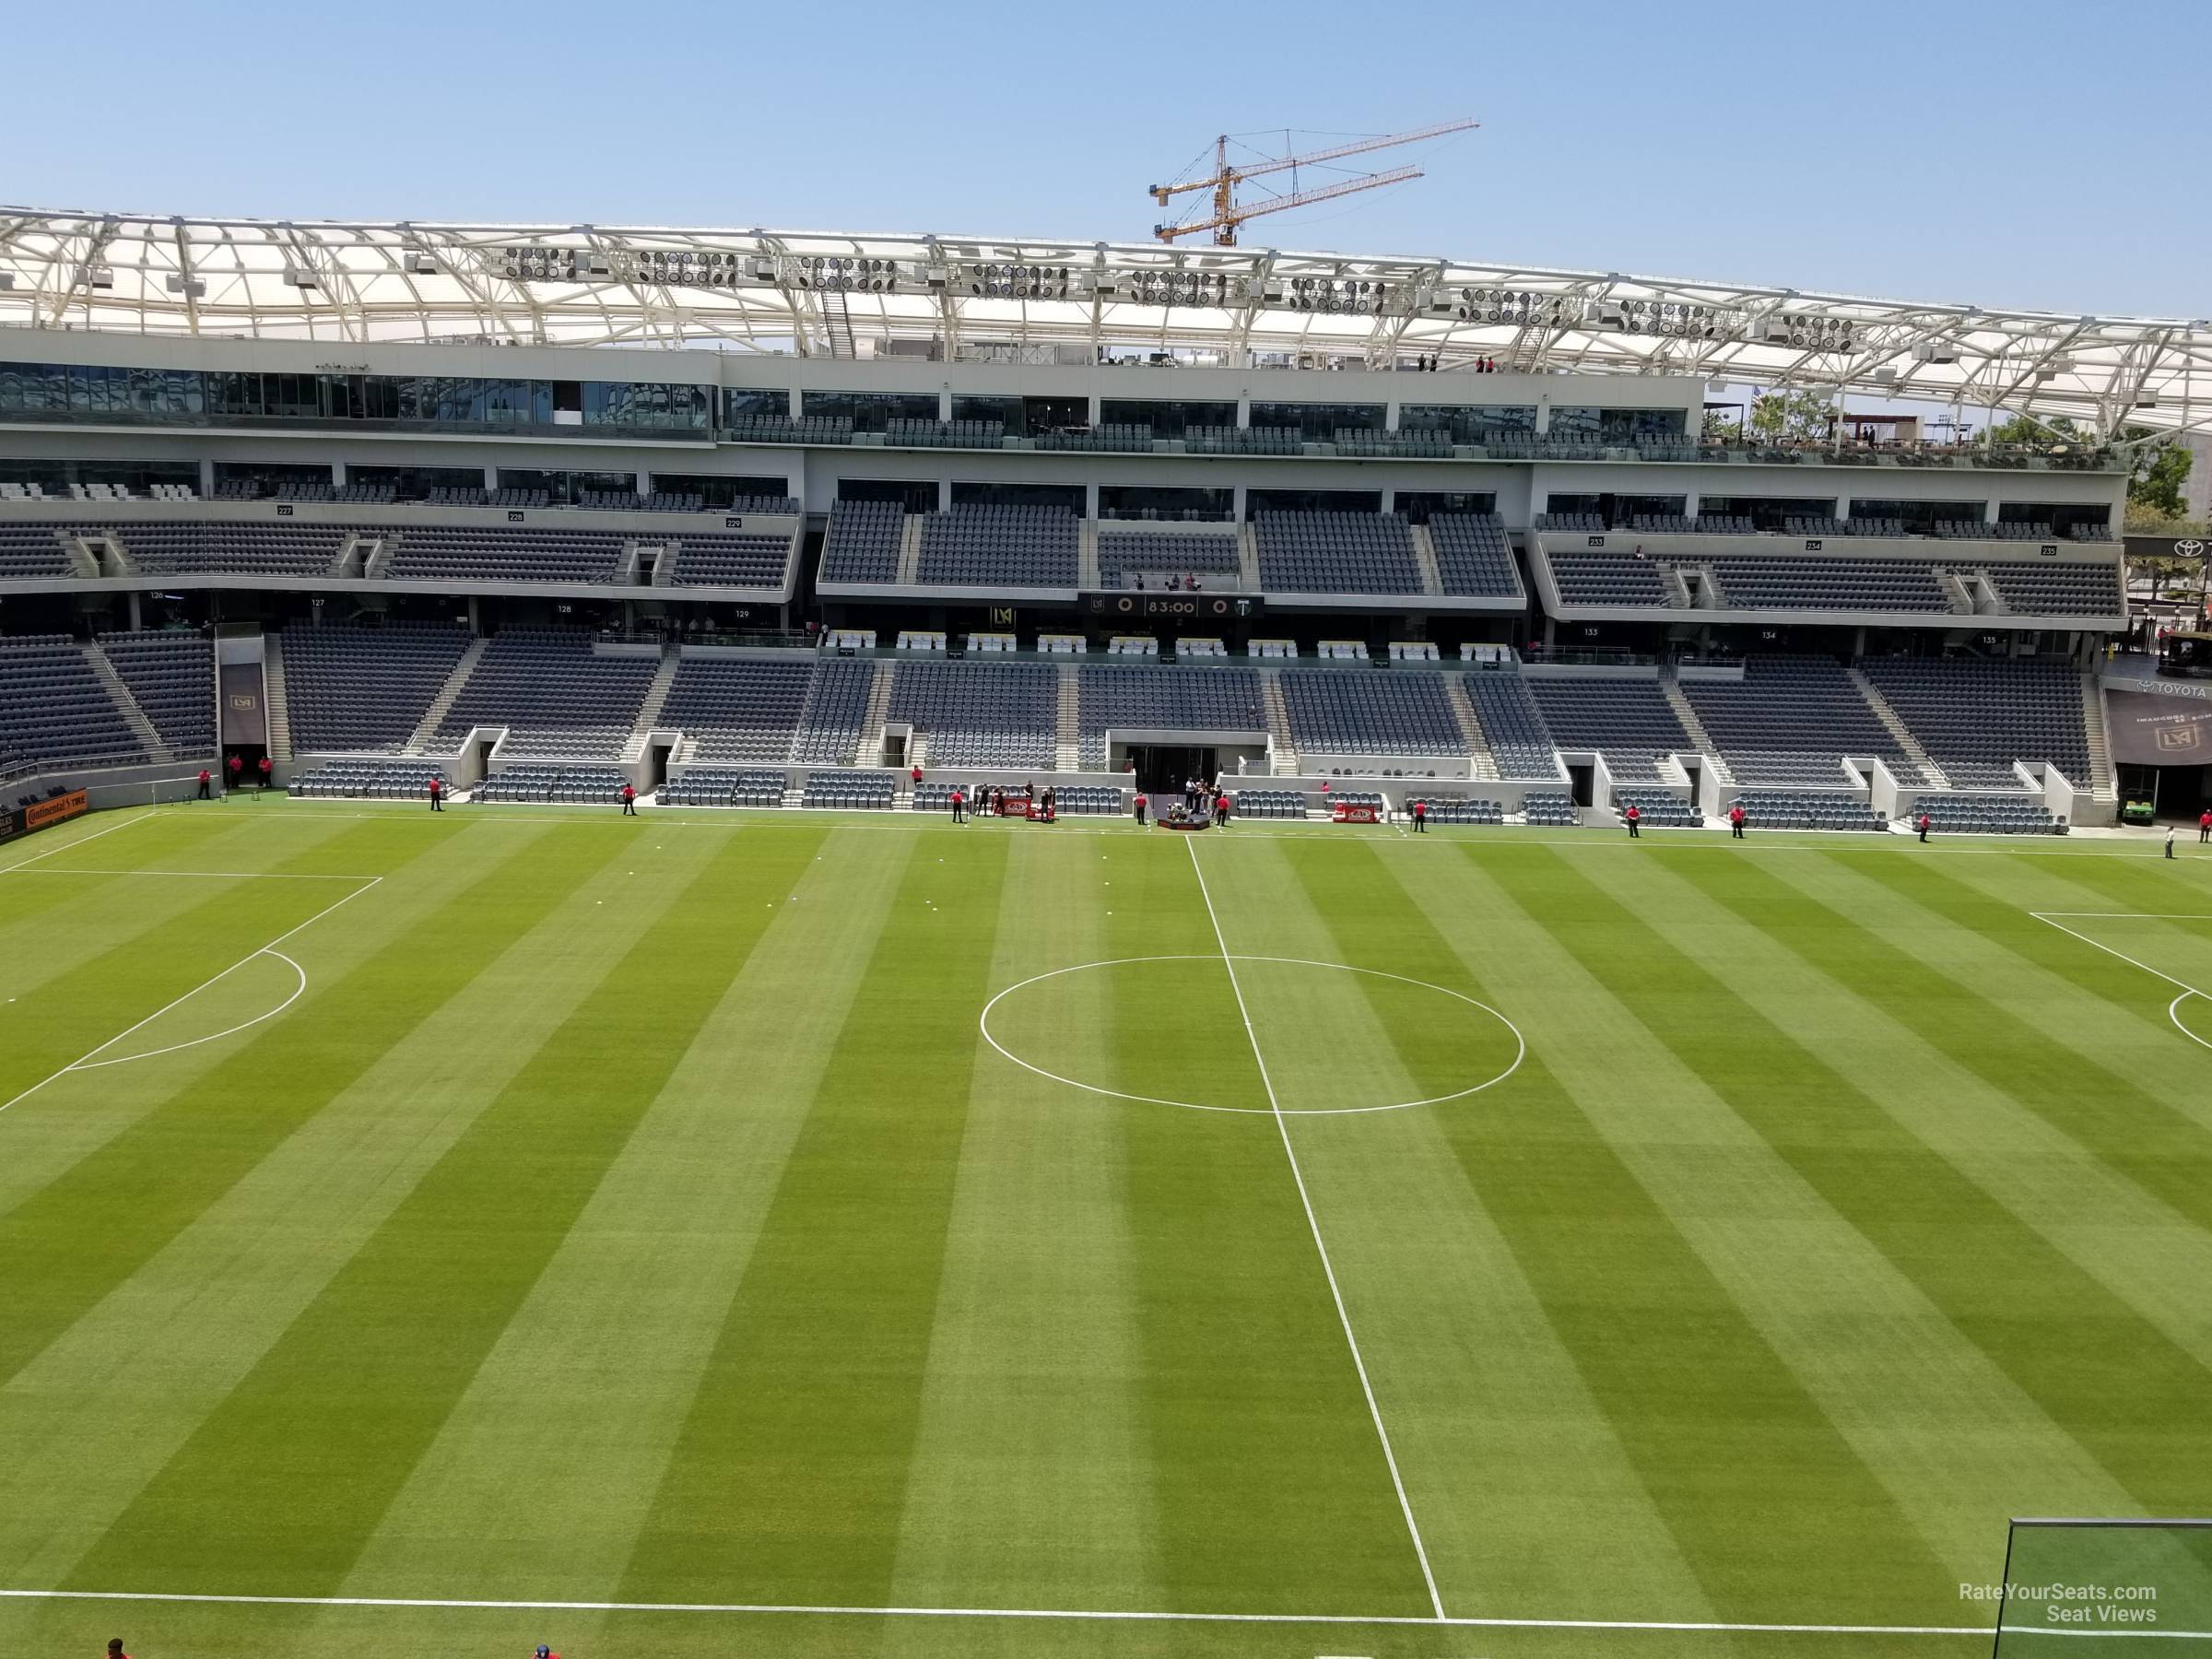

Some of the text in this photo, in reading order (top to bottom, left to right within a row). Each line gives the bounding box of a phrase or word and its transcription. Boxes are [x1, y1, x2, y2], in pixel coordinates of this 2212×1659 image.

[278, 507, 292, 515] 227
[1807, 542, 1820, 550] 234
[559, 605, 571, 613] 128
[1148, 601, 1194, 613] 83:00
[1983, 636, 1996, 644] 135
[2158, 684, 2206, 698] TOYOTA
[29, 795, 86, 824] Continental TIRE
